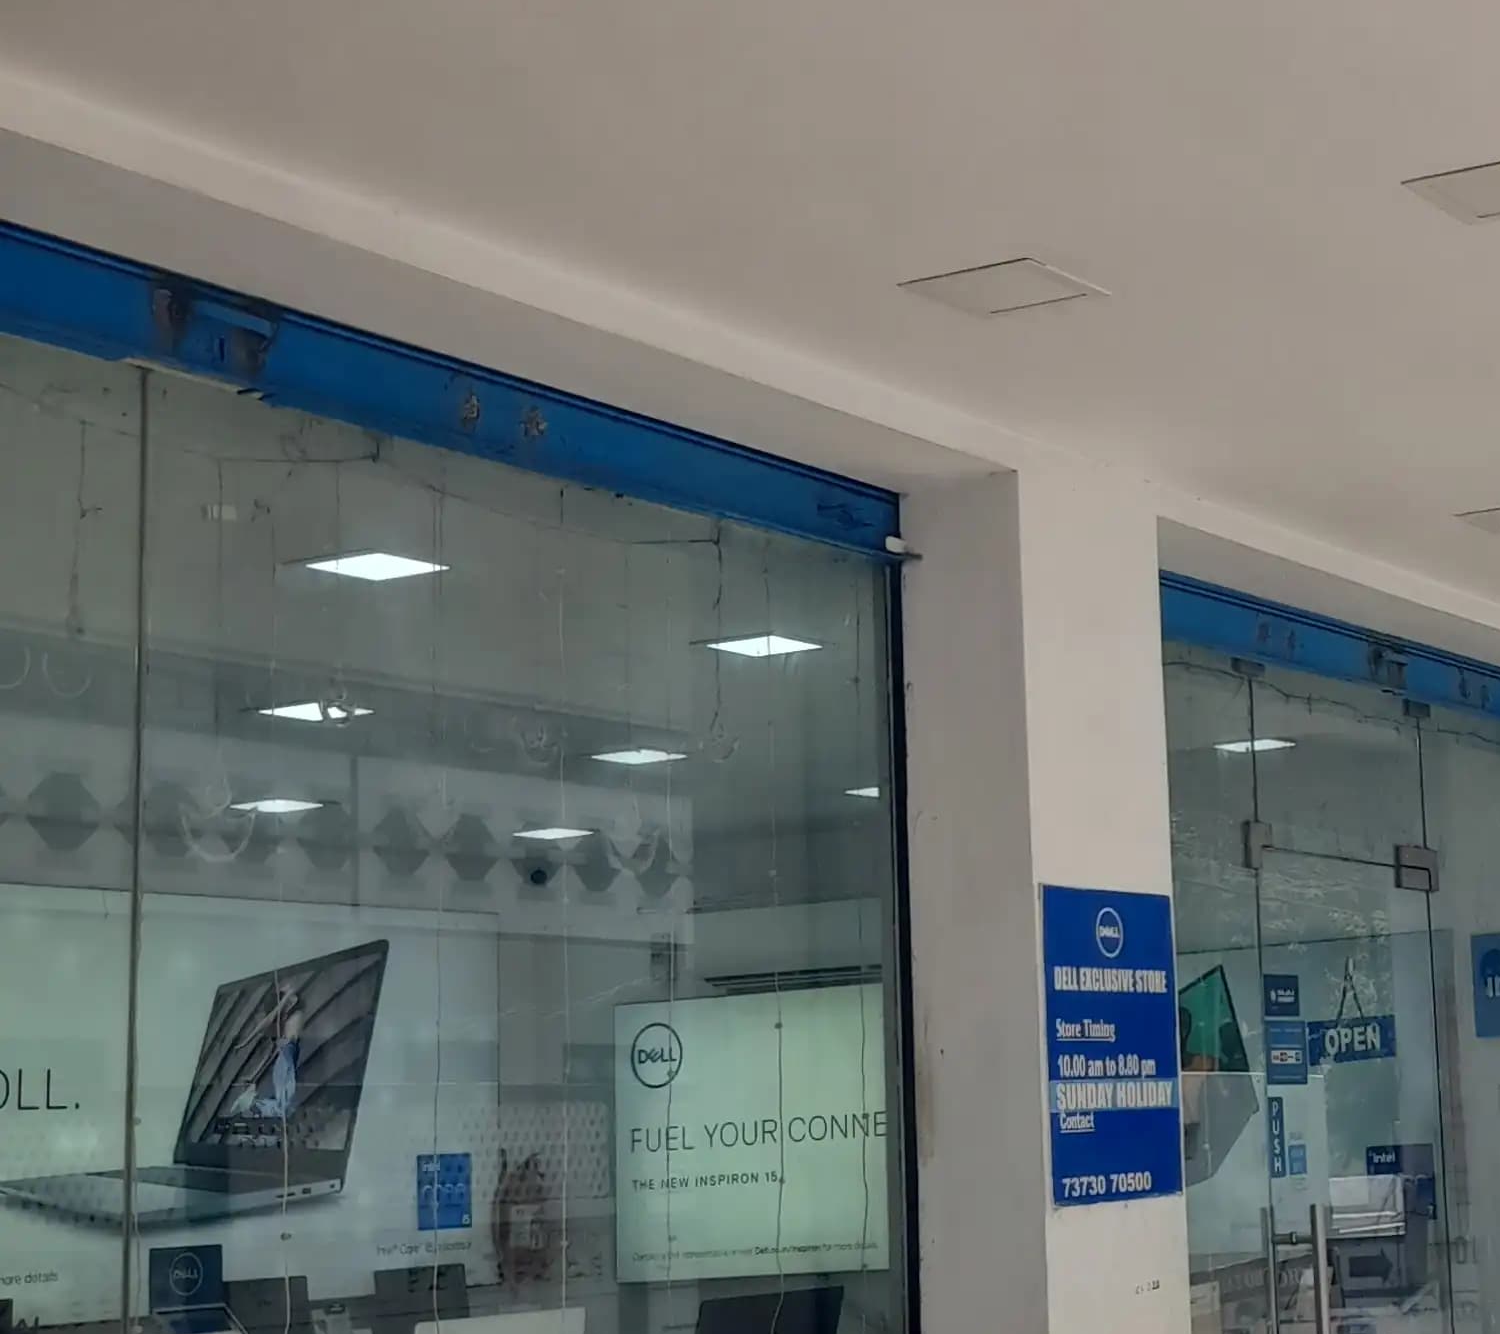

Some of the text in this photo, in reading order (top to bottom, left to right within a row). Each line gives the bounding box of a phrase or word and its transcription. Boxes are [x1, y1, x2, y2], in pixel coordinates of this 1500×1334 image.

[1054, 966, 1168, 993] DELL EXCLUSIVE STORE
[1056, 1018, 1116, 1043] Store Timing
[1324, 1022, 1381, 1052] OPEN
[638, 1046, 677, 1064] DELL
[1058, 1054, 1086, 1078] 10.00
[1088, 1059, 1104, 1077] am
[1105, 1056, 1117, 1077] to
[1141, 1058, 1156, 1079] pm
[0, 1068, 80, 1111] LL.
[1057, 1081, 1173, 1109] SUNDAY HOLIDAY
[1060, 1112, 1095, 1131] Contact
[630, 1125, 695, 1154] FUEL
[704, 1118, 778, 1148] YOUR
[1271, 1101, 1283, 1173] PUSH
[632, 1178, 655, 1191] THE
[660, 1177, 689, 1190] NEW
[694, 1172, 760, 1187] INSPIRON
[1062, 1171, 1152, 1198] 73730 70500
